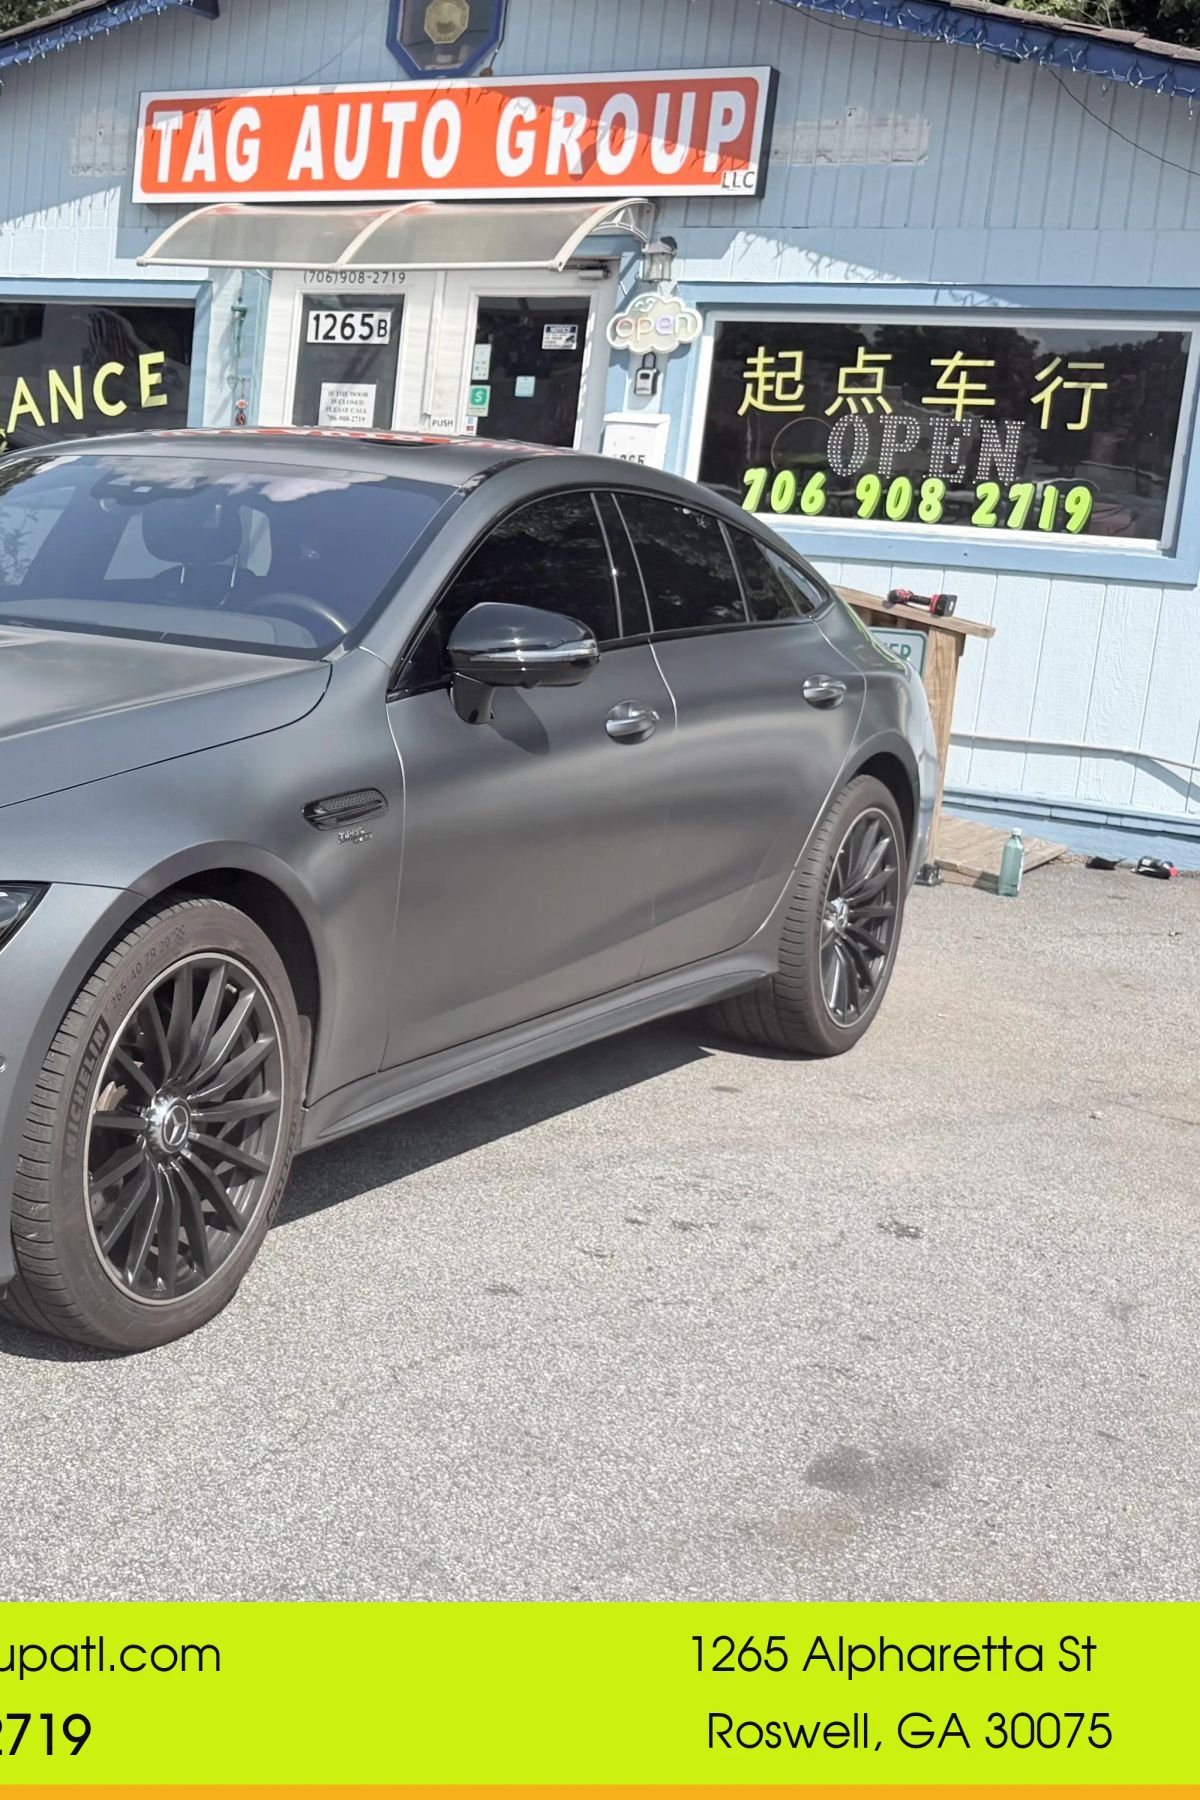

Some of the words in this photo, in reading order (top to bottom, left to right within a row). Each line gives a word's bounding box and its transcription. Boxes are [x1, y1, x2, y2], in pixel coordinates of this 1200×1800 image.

[152, 106, 261, 184] TAG
[287, 98, 462, 181] AUTO
[495, 90, 746, 178] GROUP
[721, 170, 756, 190] LLC
[303, 271, 406, 284] (706)908-2719
[616, 316, 693, 341] open
[432, 419, 454, 427] PUSH
[737, 346, 1108, 431] 起点车行
[826, 413, 1026, 486] OPEN
[741, 467, 826, 515] 706
[855, 474, 946, 524] 908
[971, 481, 1093, 534] 2719
[64, 1022, 108, 1160] MICHELIN
